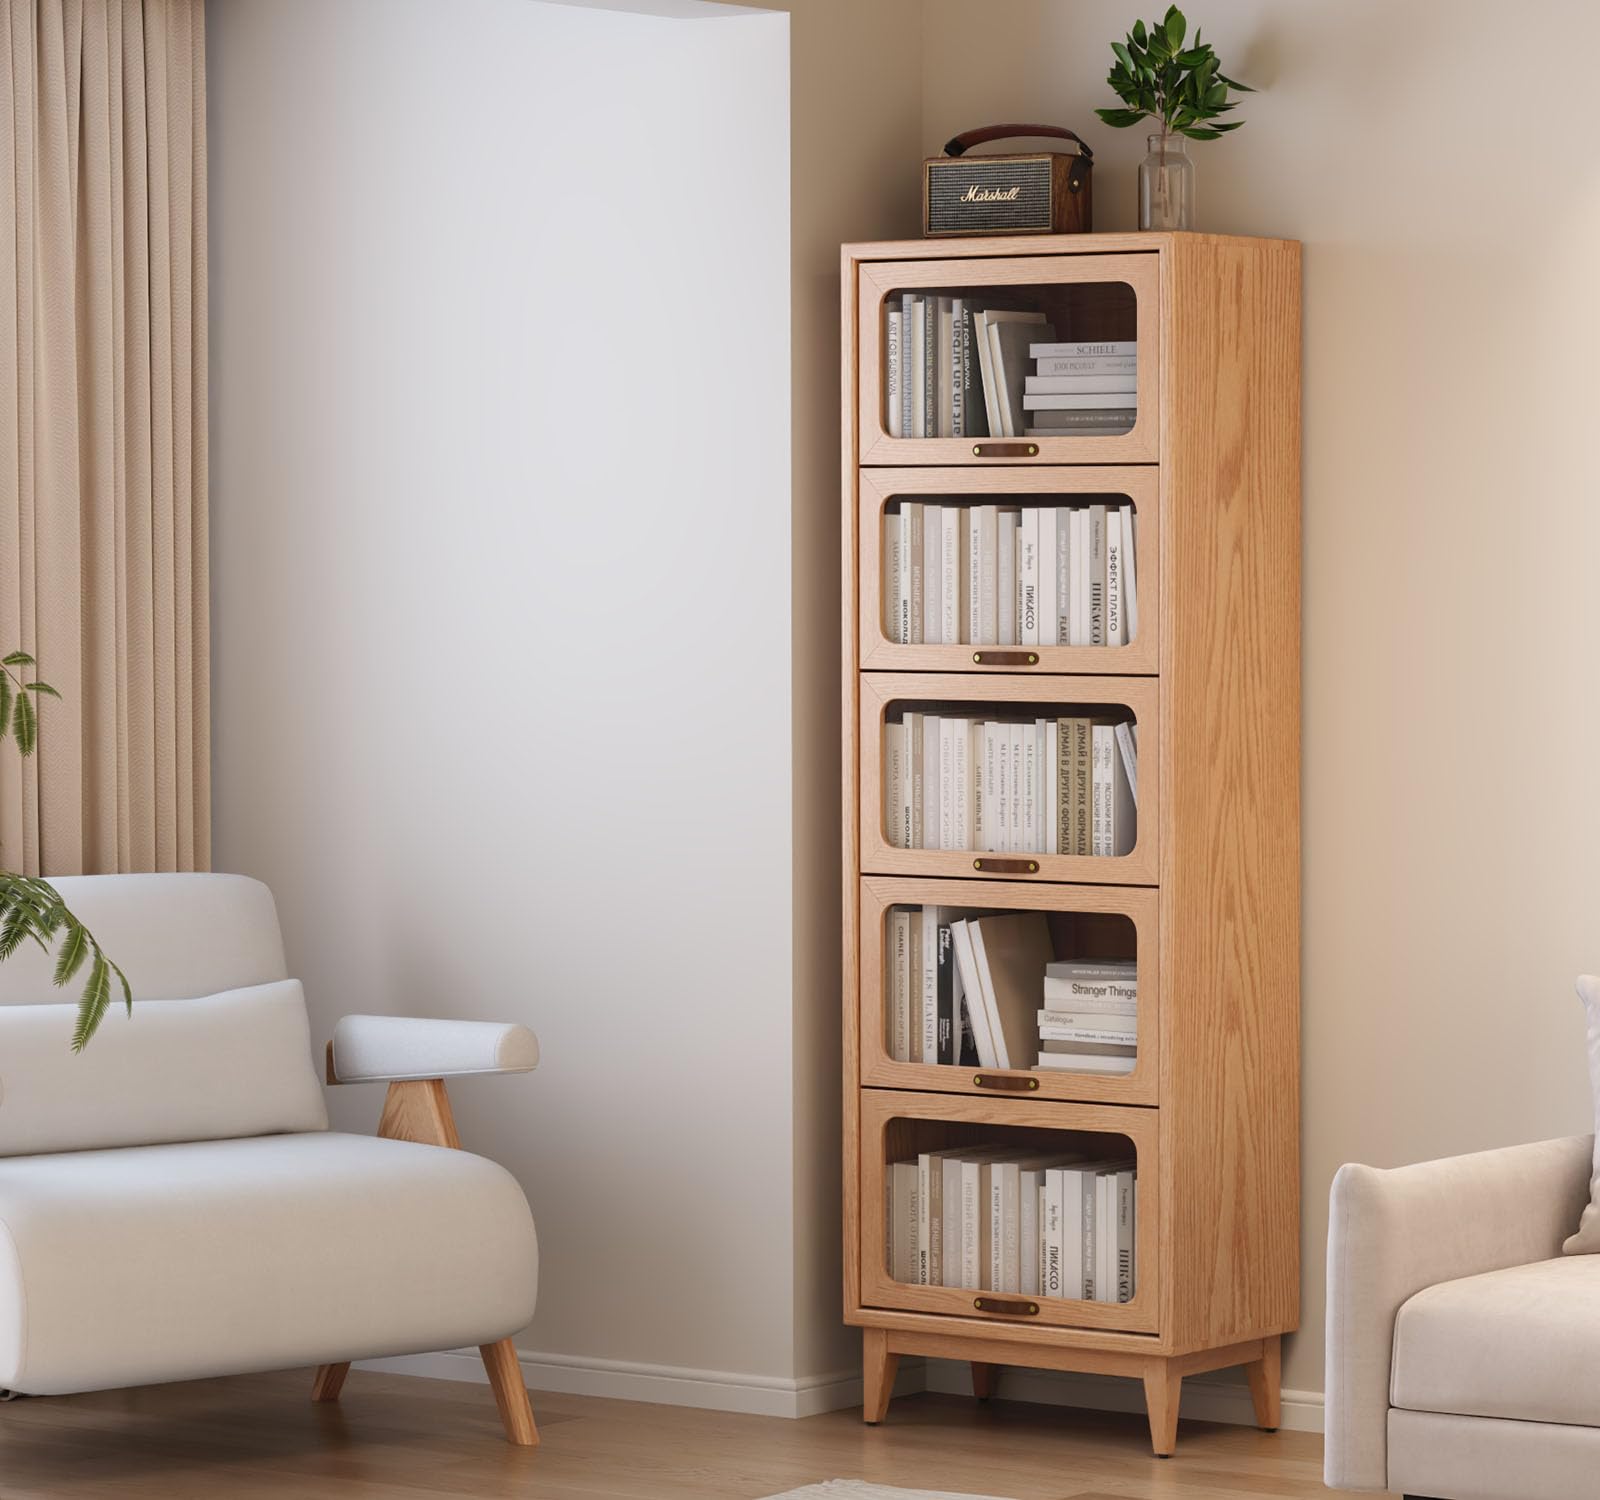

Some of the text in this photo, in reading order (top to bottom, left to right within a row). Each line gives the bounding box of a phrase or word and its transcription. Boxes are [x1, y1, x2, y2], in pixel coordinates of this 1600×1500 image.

[960, 184, 1020, 202] Marshall
[889, 320, 897, 397] ART FOR SURVIVAL
[963, 308, 971, 391] ART FOR SURVIVAL
[1075, 344, 1118, 355] SCHIELE
[952, 319, 961, 435] art in an urban
[1026, 585, 1034, 630] ПИКАССО
[1110, 546, 1119, 633] ЭФФЕКТ ПЛАТО
[1061, 723, 1071, 756] ДУМАЙ
[1077, 723, 1087, 757] ДУМАЙ
[1061, 769, 1071, 806] ДРУГИХ
[1077, 769, 1087, 806] ДРУГИХ
[925, 969, 935, 1051] LES PLAISIRS
[1072, 983, 1136, 1000] Stranger Things
[1050, 1246, 1059, 1290] ПИКАССО
